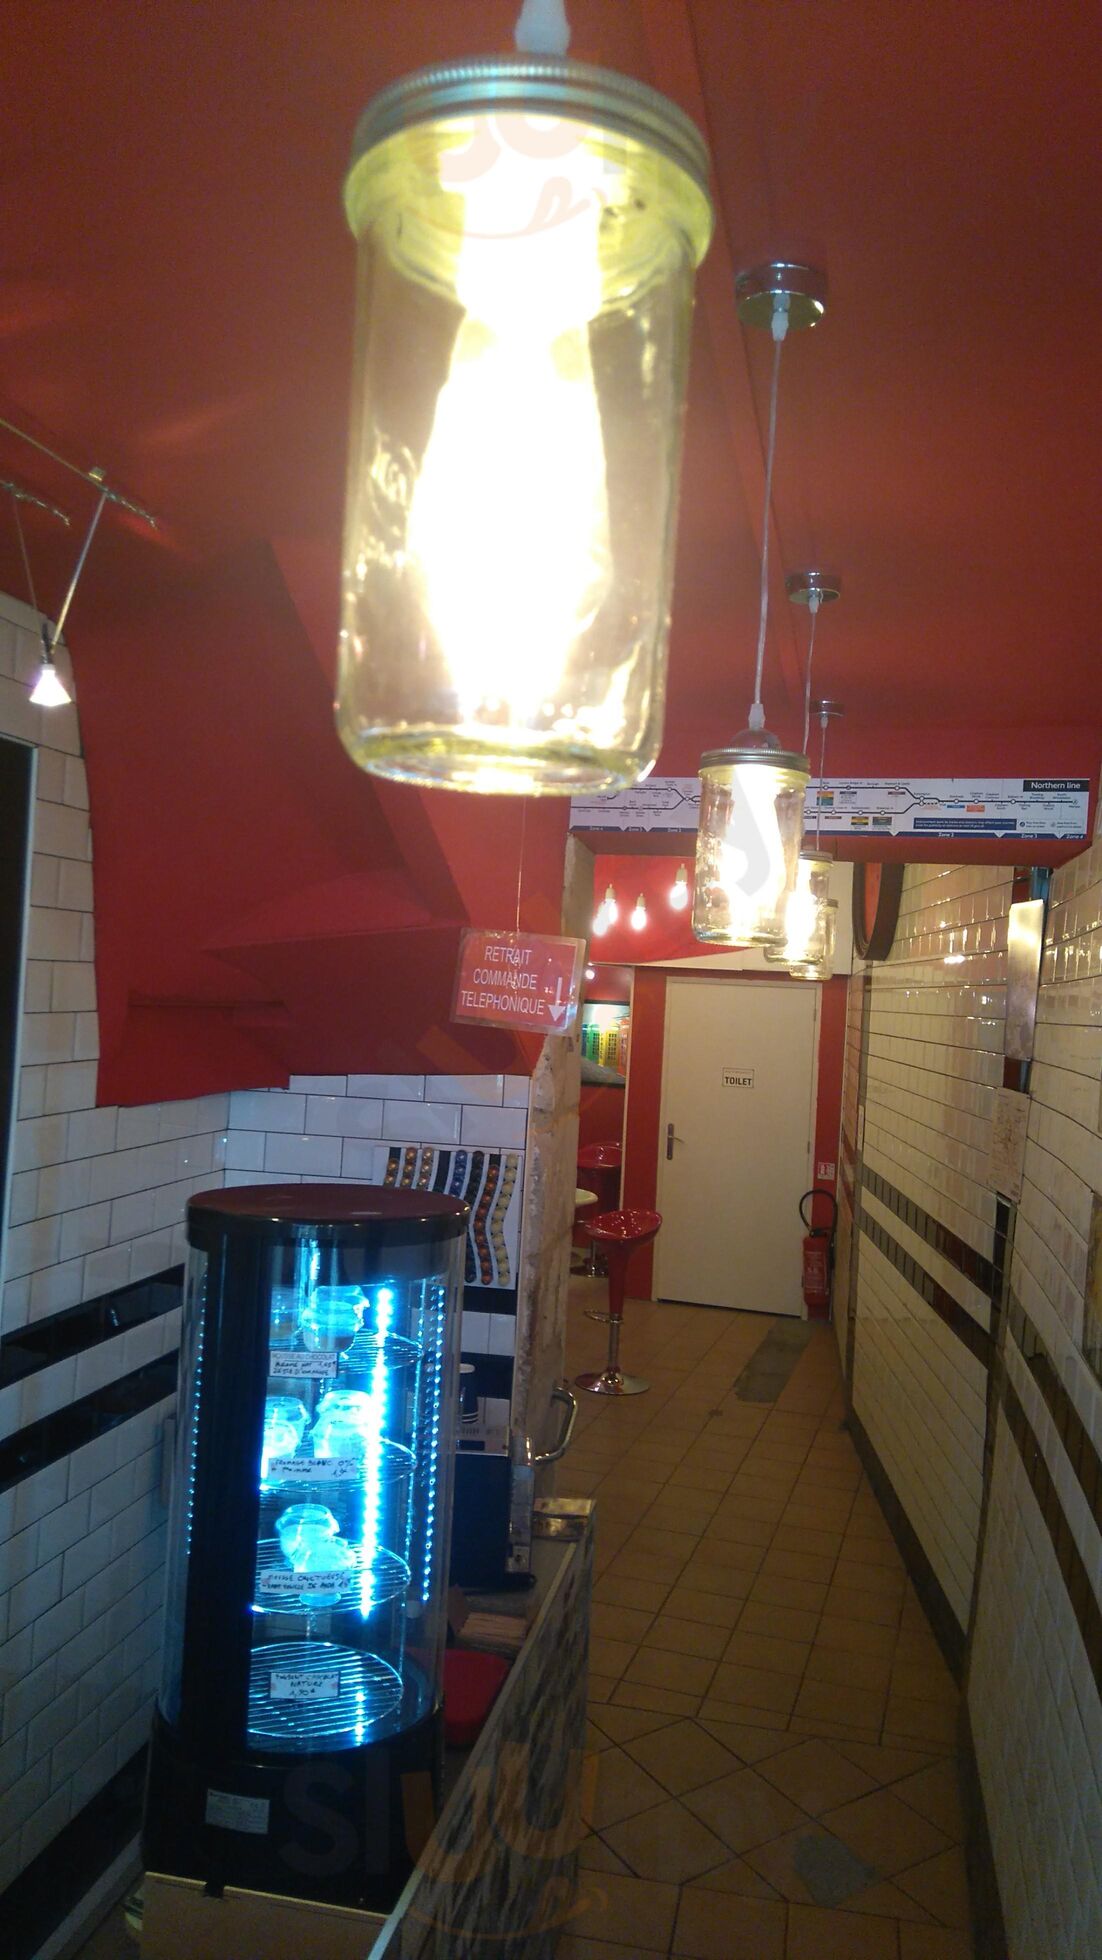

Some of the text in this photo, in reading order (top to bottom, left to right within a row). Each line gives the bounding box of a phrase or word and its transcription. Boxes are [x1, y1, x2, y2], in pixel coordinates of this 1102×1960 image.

[1031, 781, 1081, 790] Northern line
[484, 945, 532, 965] RETRAIT
[473, 968, 538, 989] COMMANDE
[461, 990, 545, 1015] TELEPHONIQUE
[725, 1076, 752, 1086] TOILET
